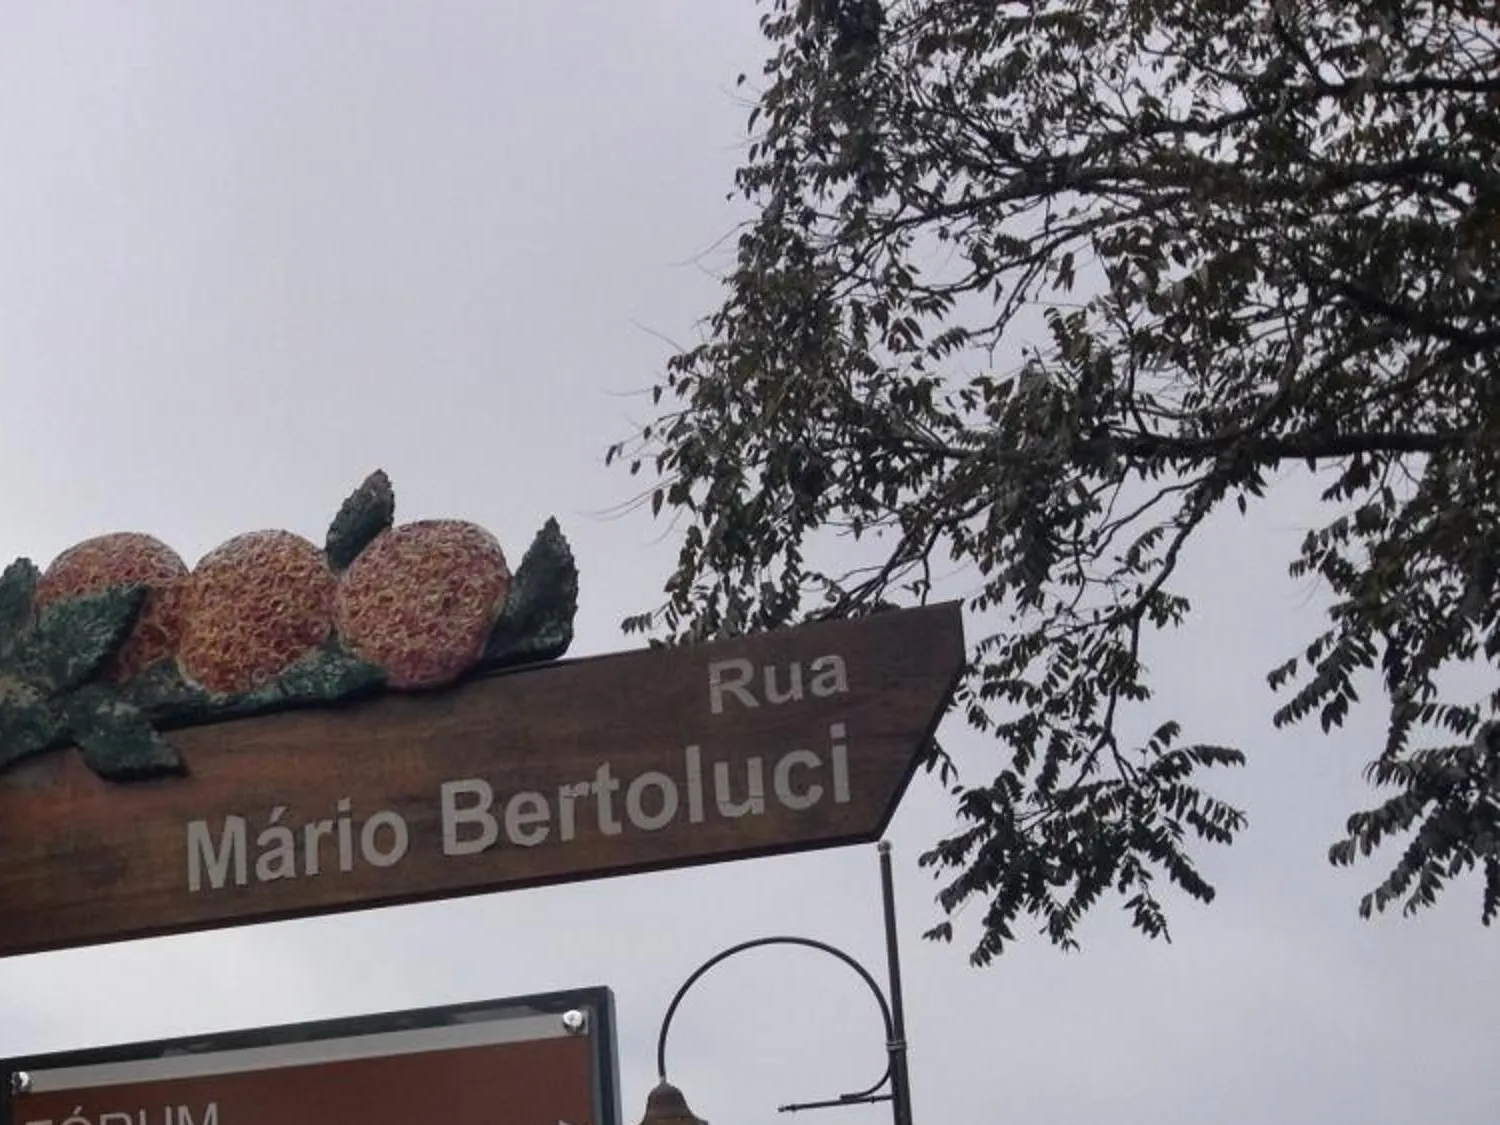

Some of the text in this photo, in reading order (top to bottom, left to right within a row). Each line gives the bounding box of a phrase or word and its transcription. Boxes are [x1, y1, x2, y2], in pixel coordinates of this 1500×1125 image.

[708, 653, 850, 715] Rua
[186, 723, 853, 893] Mário Bertoluci
